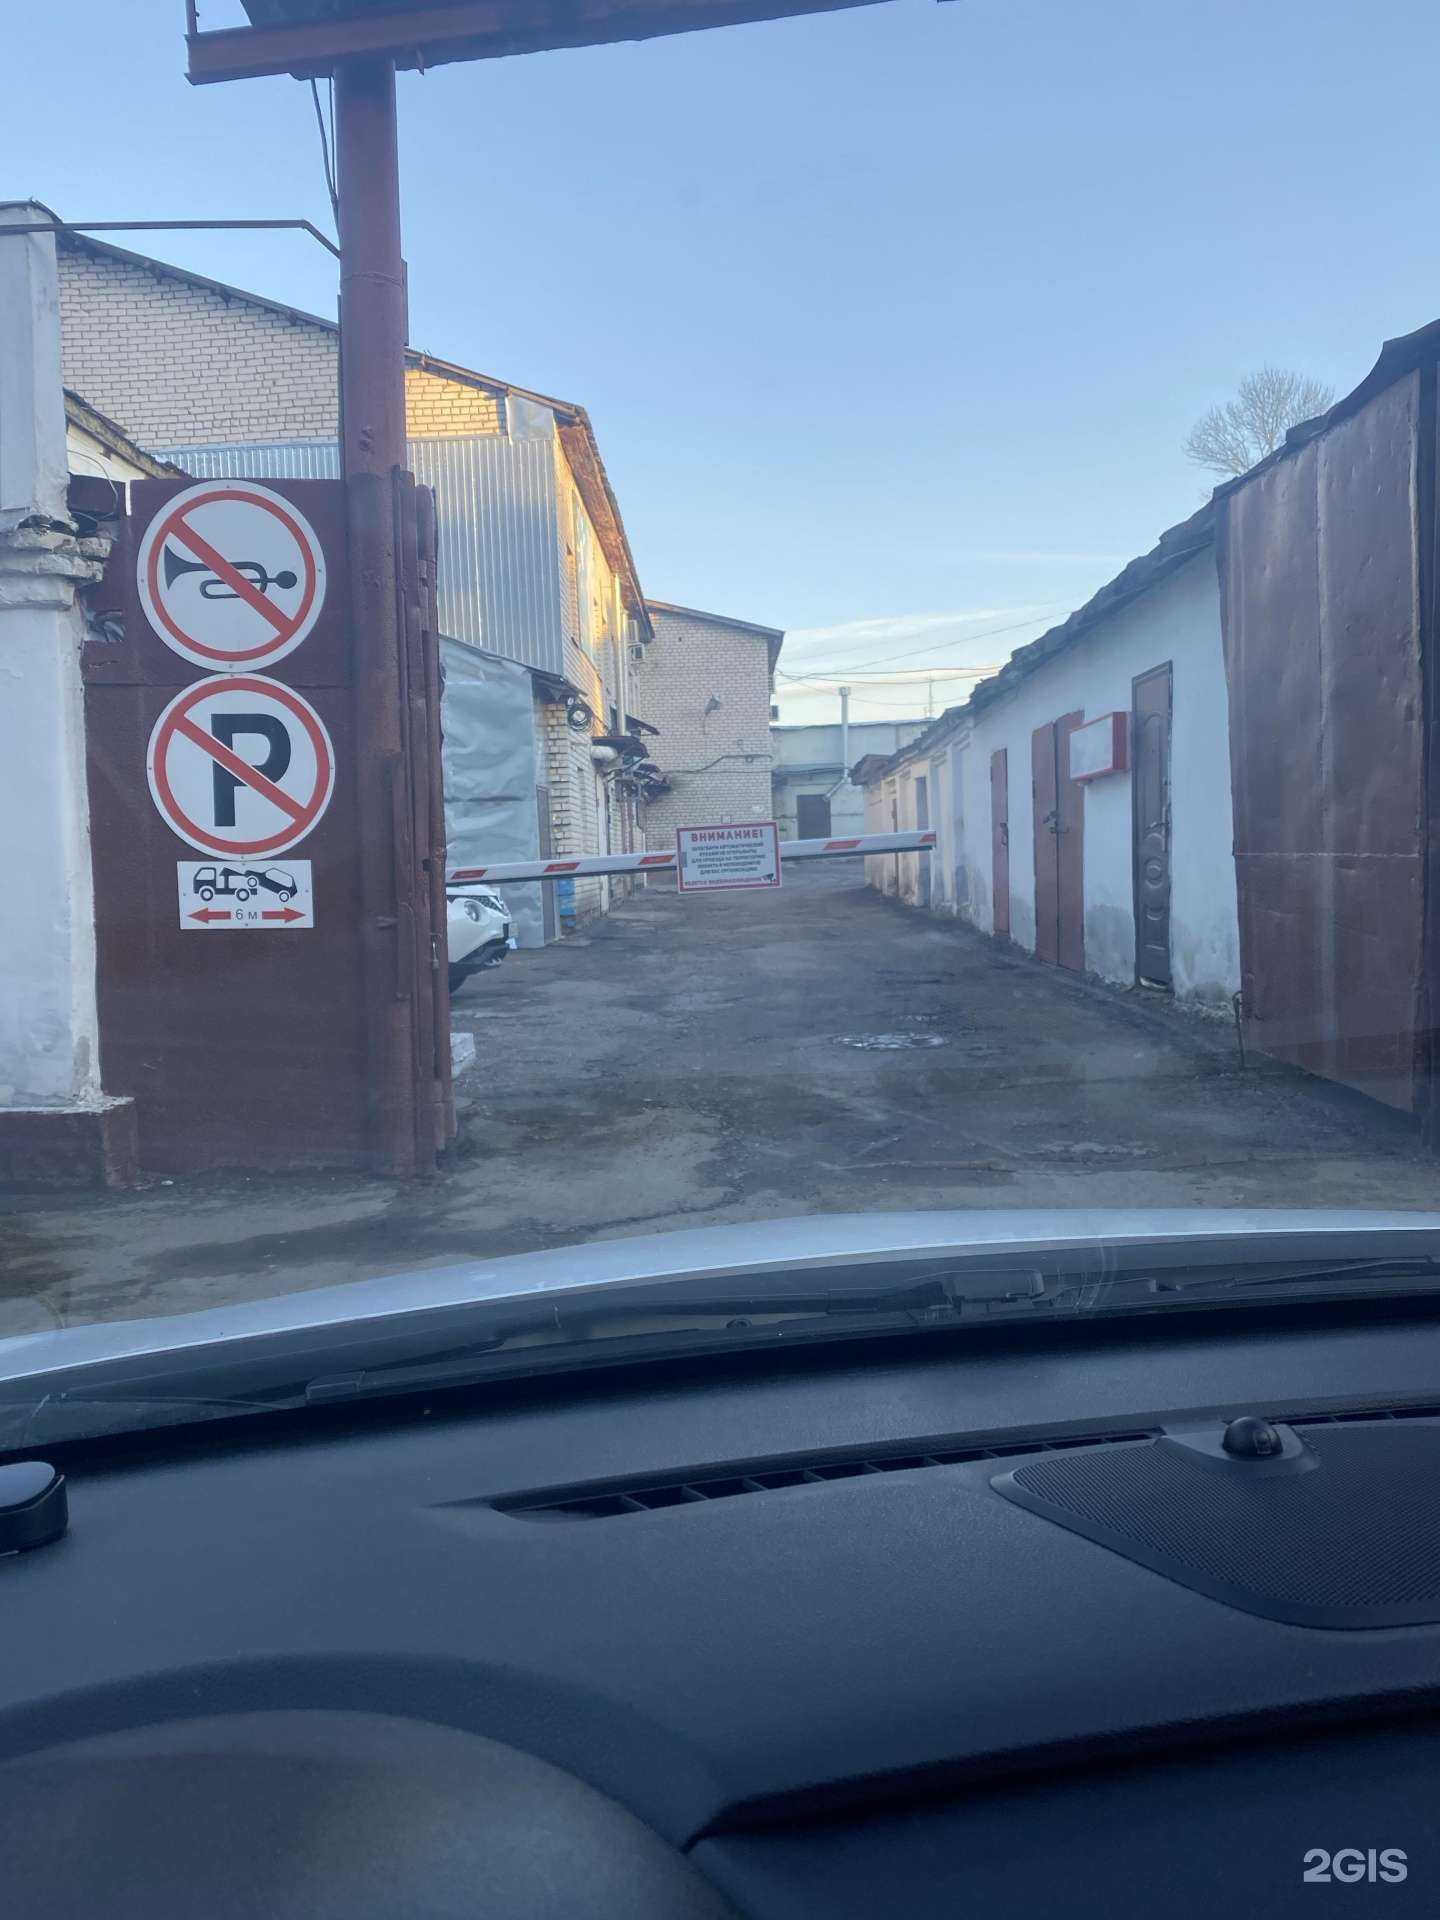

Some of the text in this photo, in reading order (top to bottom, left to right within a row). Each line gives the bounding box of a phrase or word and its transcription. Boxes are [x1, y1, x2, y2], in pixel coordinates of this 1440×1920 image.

[211, 713, 291, 827] P
[691, 829, 763, 842] ВНИМАНИЕ!
[236, 909, 243, 920] 6
